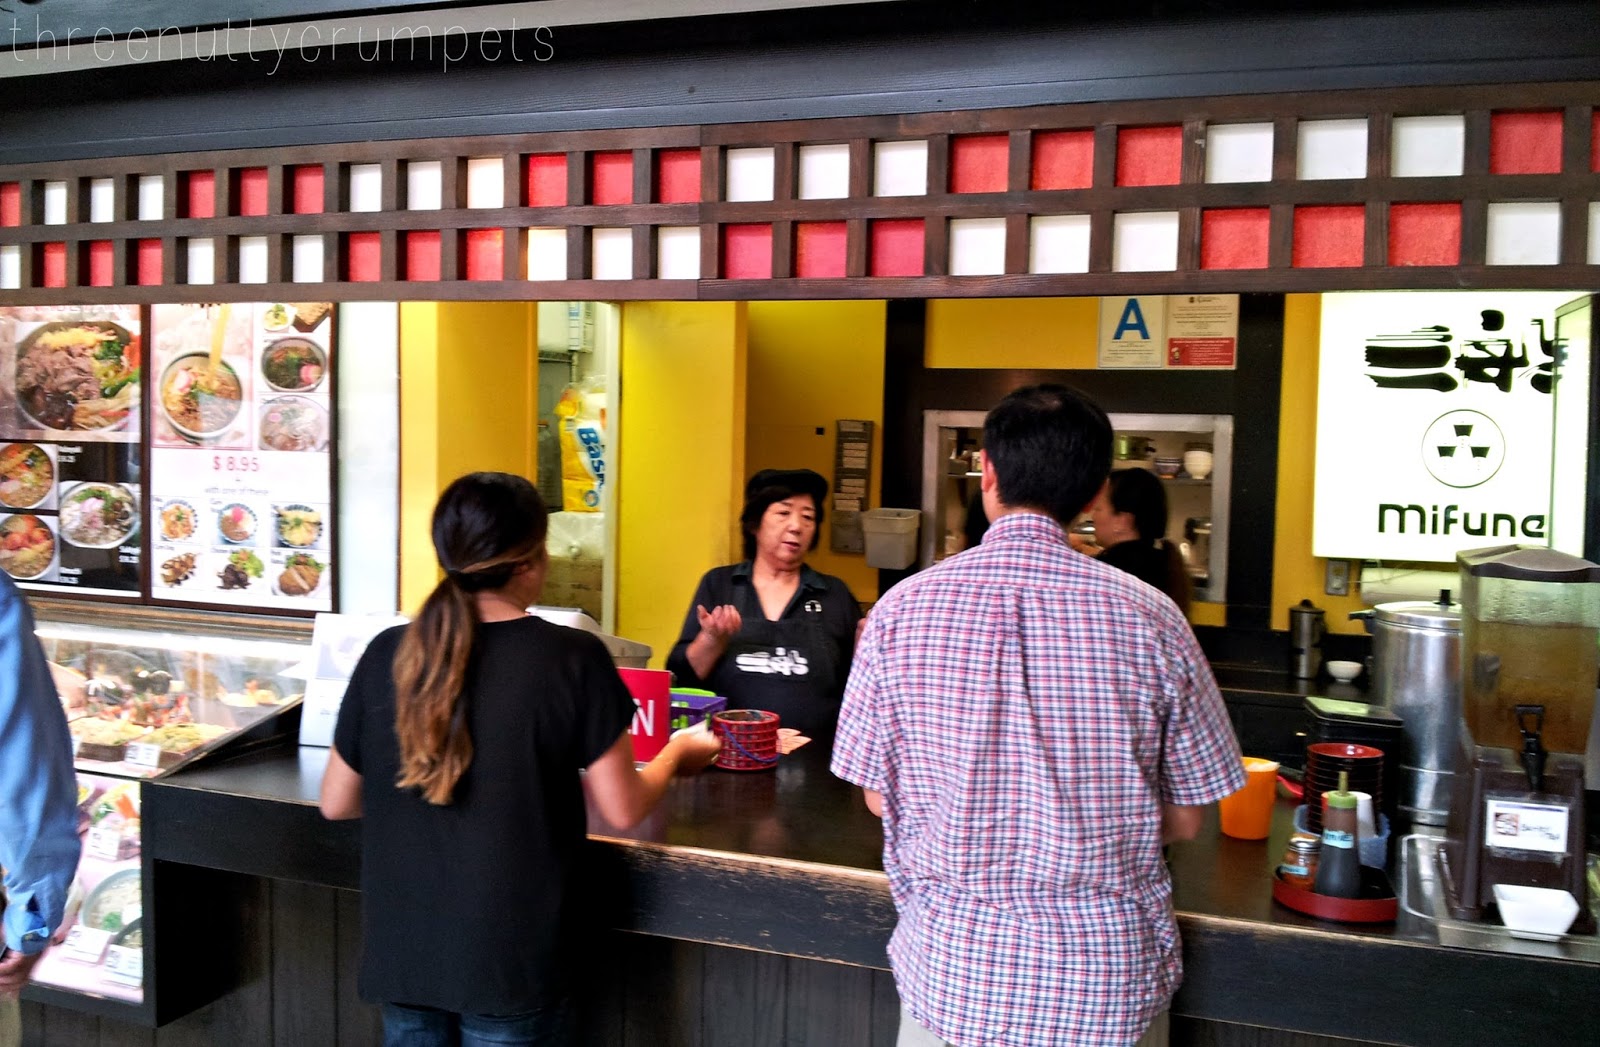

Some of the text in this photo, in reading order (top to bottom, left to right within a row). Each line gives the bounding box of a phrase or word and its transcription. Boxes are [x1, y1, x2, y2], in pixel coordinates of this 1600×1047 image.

[1112, 297, 1151, 340] A
[1377, 503, 1546, 539] mifune
[628, 698, 655, 737] N
